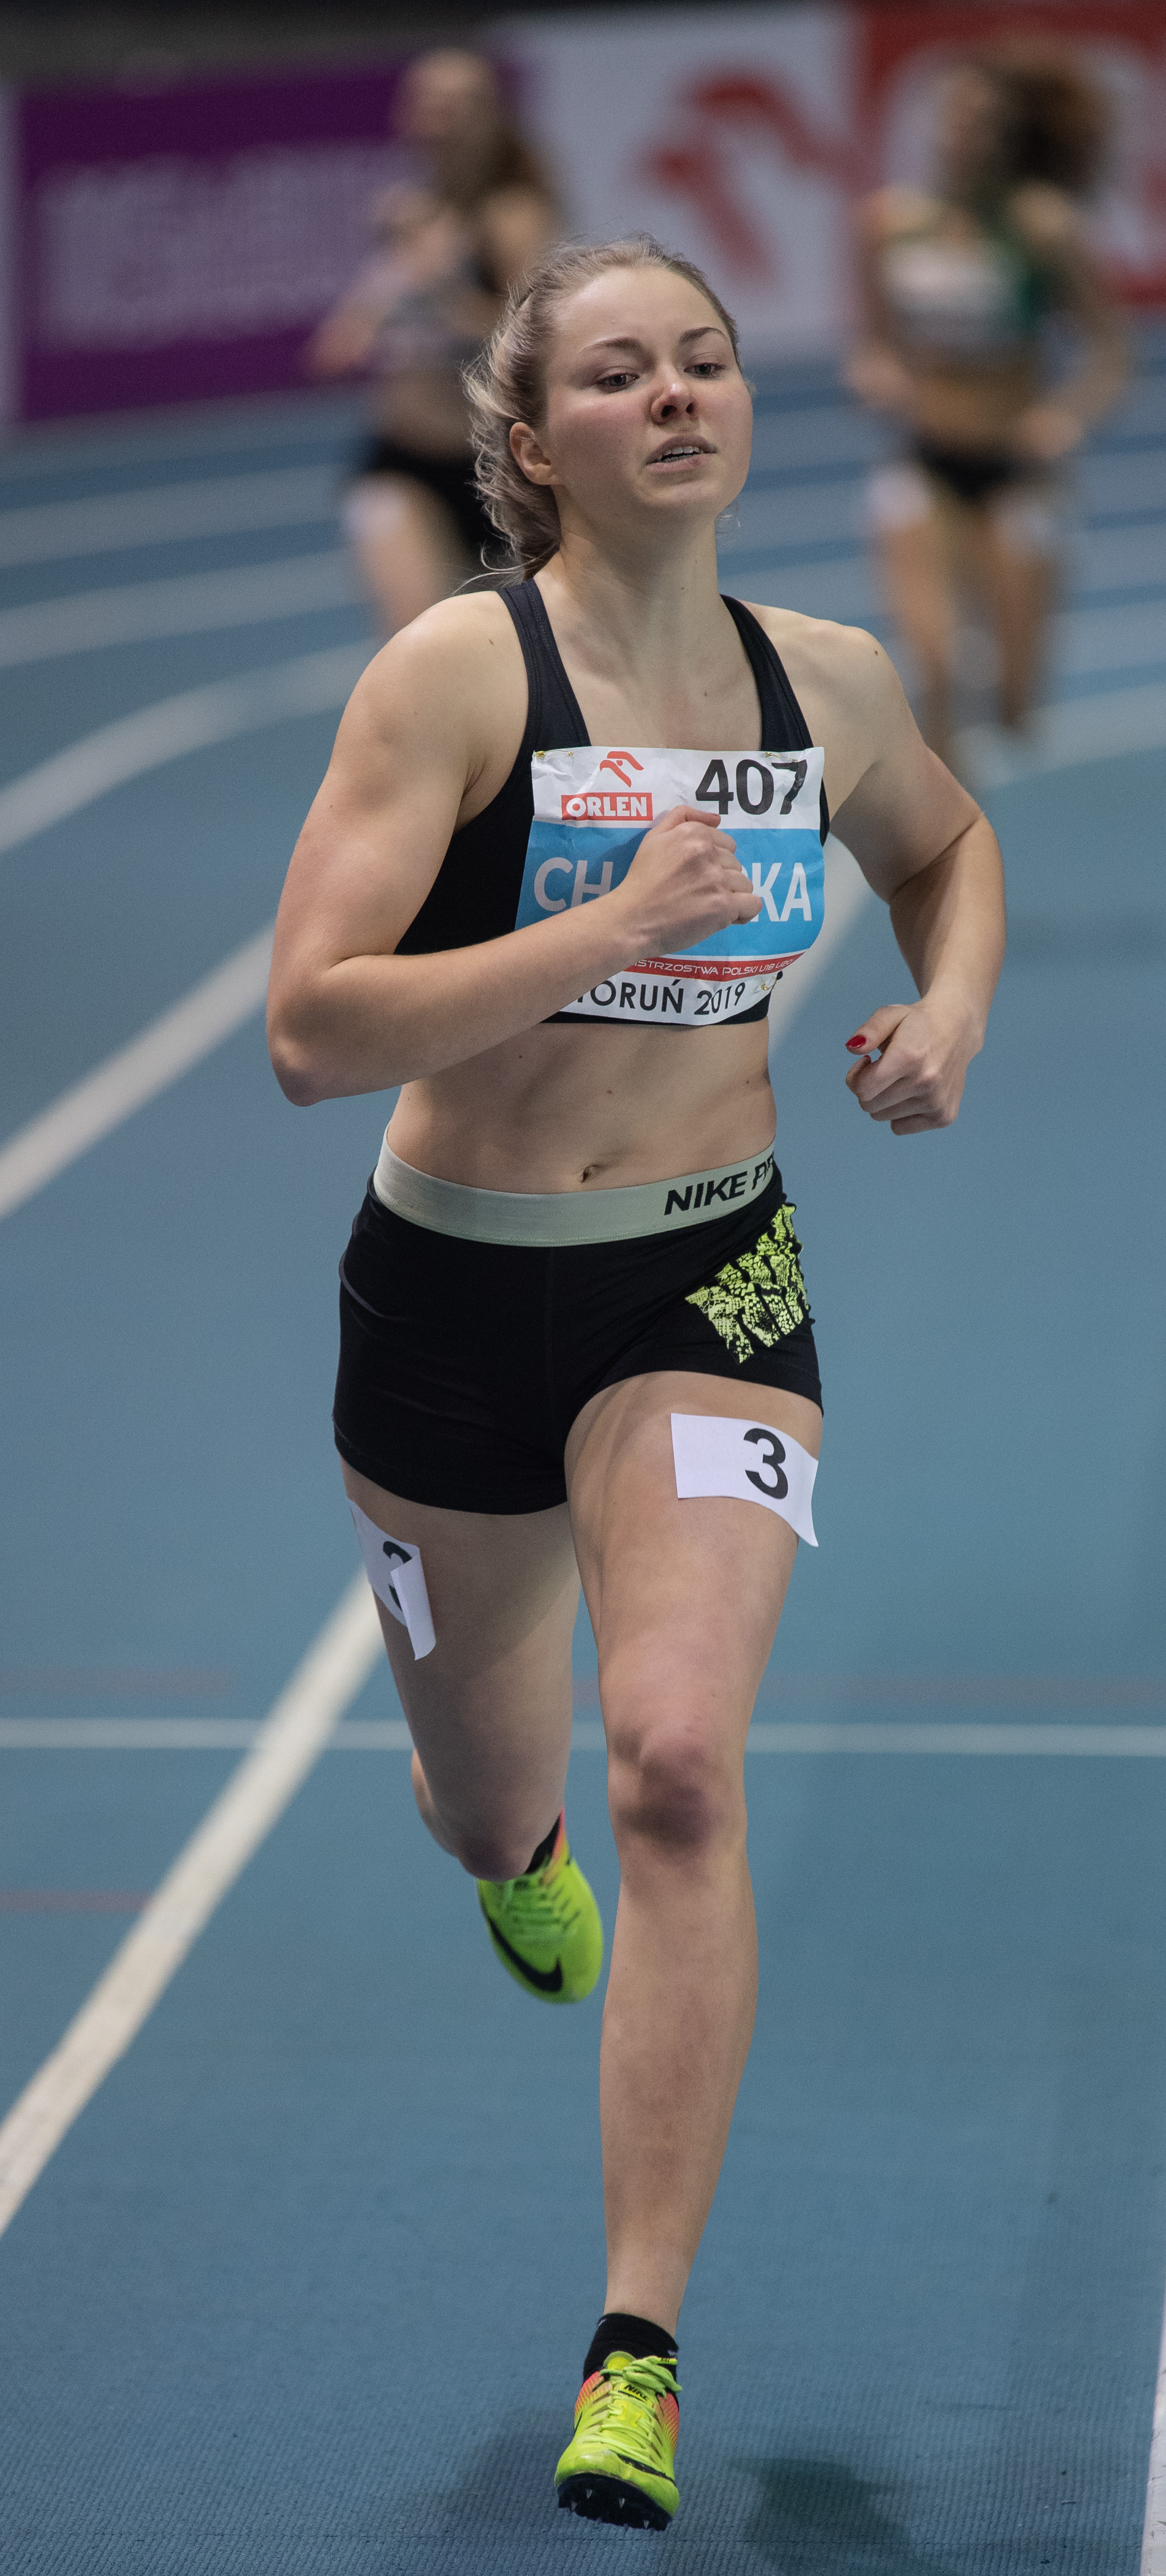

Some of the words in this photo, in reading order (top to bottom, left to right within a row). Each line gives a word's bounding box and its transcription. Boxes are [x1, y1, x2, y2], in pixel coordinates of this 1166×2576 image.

[566, 796, 648, 818] ORLEN
[695, 759, 808, 816] 407
[634, 960, 719, 975] ISTRZOSTWA
[722, 965, 758, 976] POLSKI
[759, 963, 775, 972] U18
[776, 959, 793, 969] U20
[578, 979, 684, 1013] ORUŃ
[694, 982, 746, 1015] 2019
[664, 1170, 748, 1216] NIKE
[743, 1428, 789, 1499] 3
